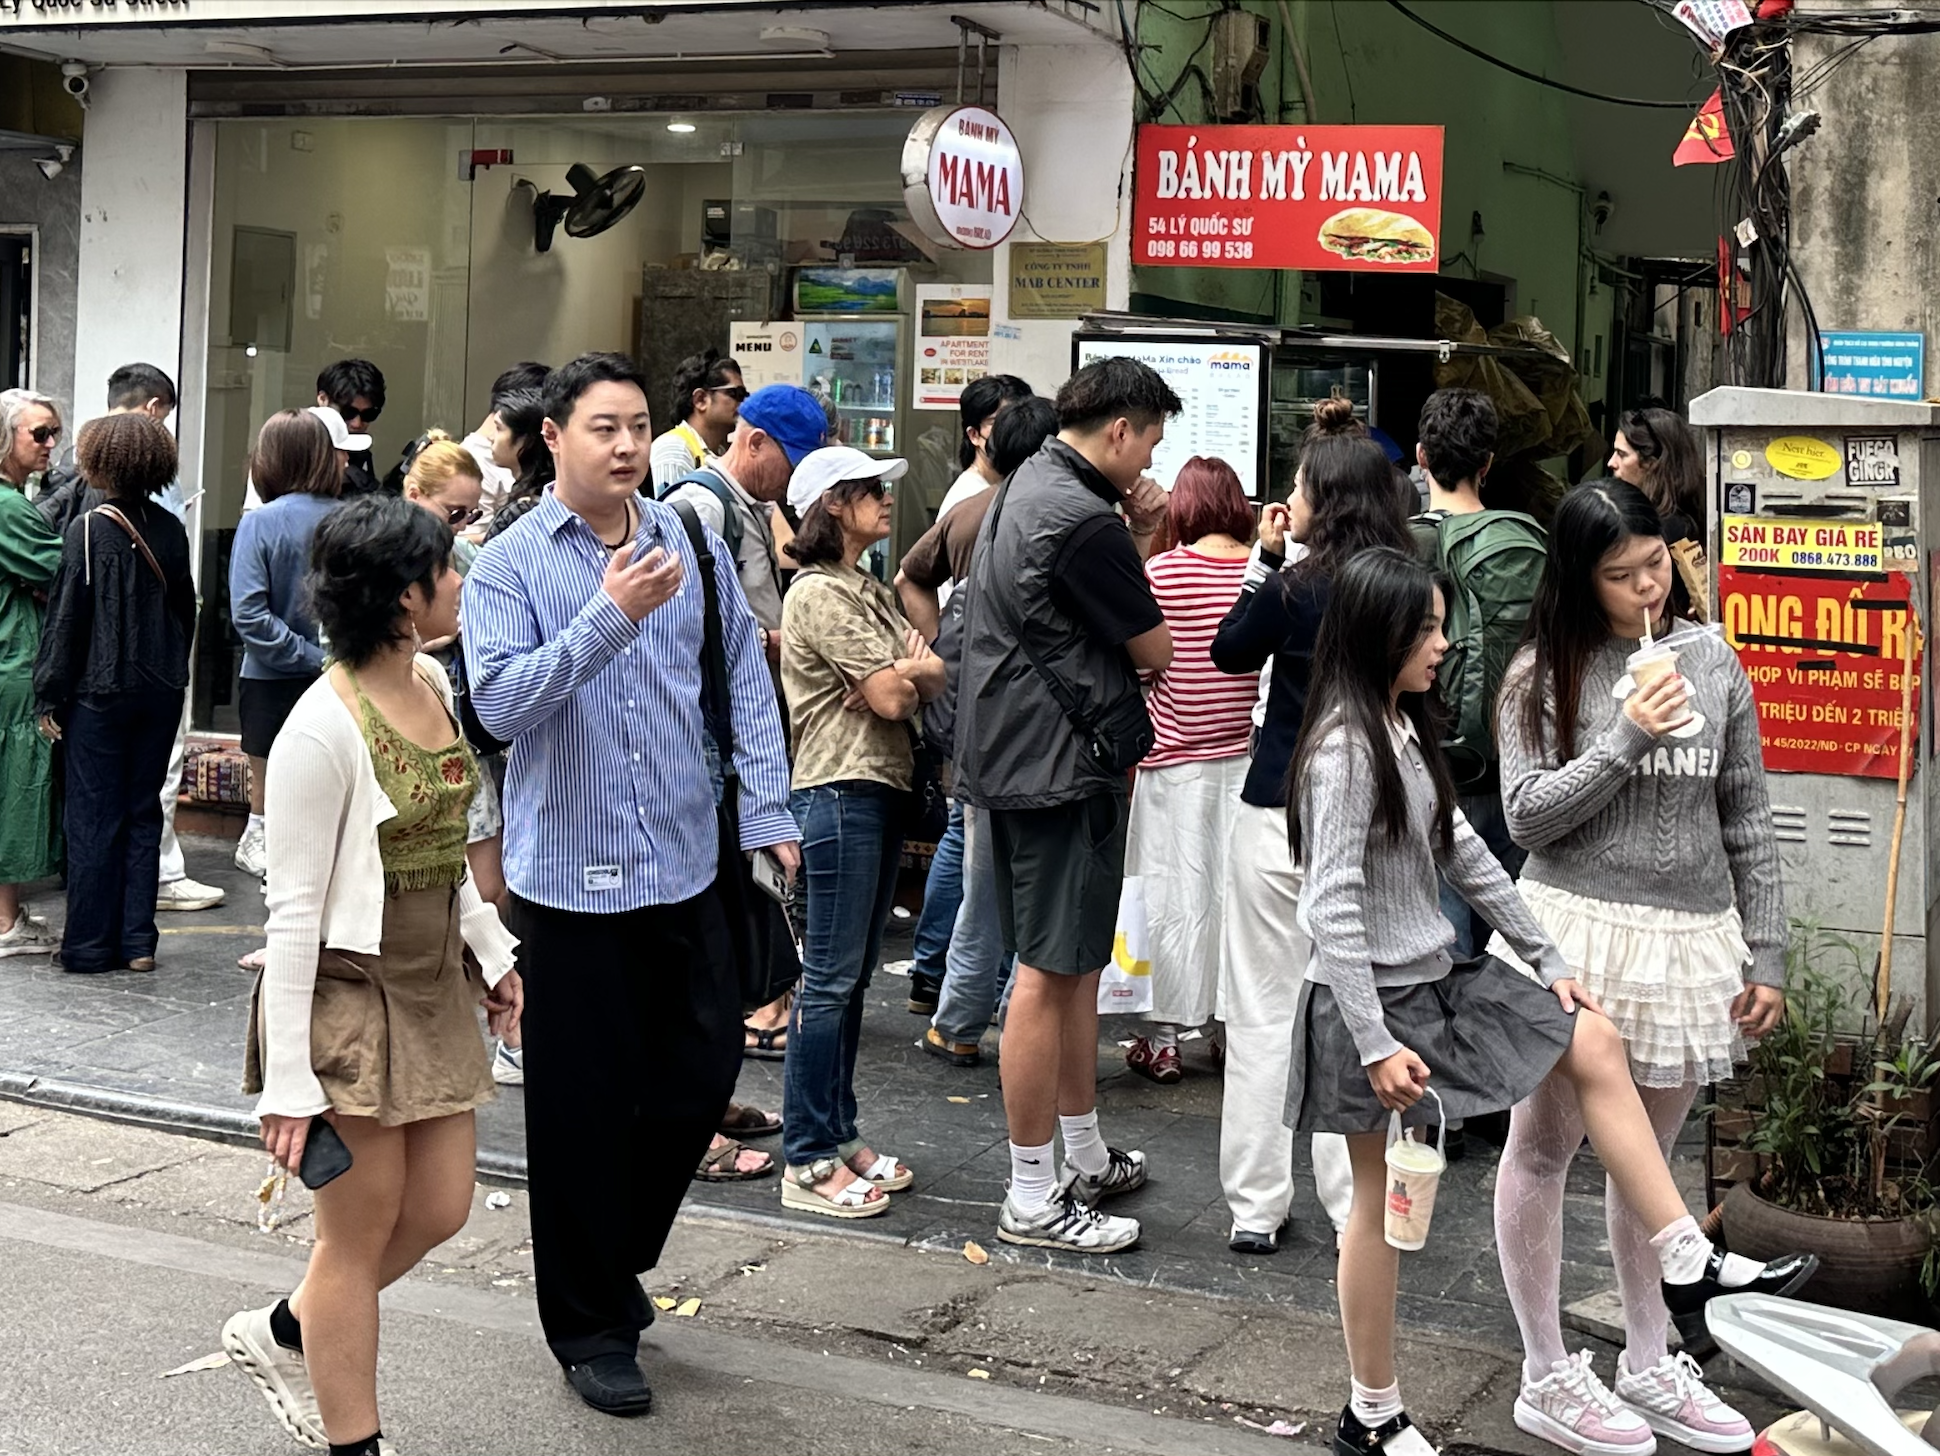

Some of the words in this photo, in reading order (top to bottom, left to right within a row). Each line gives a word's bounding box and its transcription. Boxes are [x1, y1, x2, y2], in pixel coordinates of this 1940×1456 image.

[1156, 135, 1254, 199] BÁNH
[1259, 135, 1313, 201] MỲ
[1319, 150, 1428, 202] MAMA
[938, 151, 1012, 217] MAMA
[1148, 217, 1167, 235] 54
[1170, 213, 1186, 235] LÝ
[1190, 211, 1229, 237] QUỐC
[1147, 239, 1175, 258] 098
[1179, 240, 1199, 258] 66
[1201, 241, 1220, 259] 99
[1224, 240, 1254, 260] 538
[1052, 262, 1063, 271] TY
[1014, 277, 1044, 289] MAB
[1047, 276, 1100, 289] CENTER
[735, 342, 772, 352] MENU
[940, 340, 989, 348] APARTMENT
[949, 348, 965, 358] FOR
[967, 349, 989, 358] RENT
[950, 359, 989, 367] WESTLAKE
[1159, 355, 1176, 365] Xin
[1178, 355, 1202, 365] chào
[1210, 360, 1250, 371] mama
[1727, 522, 1766, 544] SÂN
[1773, 525, 1808, 546] BAY
[1815, 525, 1848, 547] GIÁ
[1854, 524, 1879, 549] RẺ
[1738, 547, 1780, 563] 200K
[1791, 551, 1878, 567] 0868.473.888
[1808, 669, 1858, 690] PHẠM
[1863, 669, 1884, 690] SẼ
[1759, 700, 1807, 724] TRIỆU
[1811, 700, 1847, 724] ĐẾN
[1851, 708, 1862, 725] 2
[1867, 706, 1915, 731] TRIỆ
[1844, 742, 1861, 752] CP
